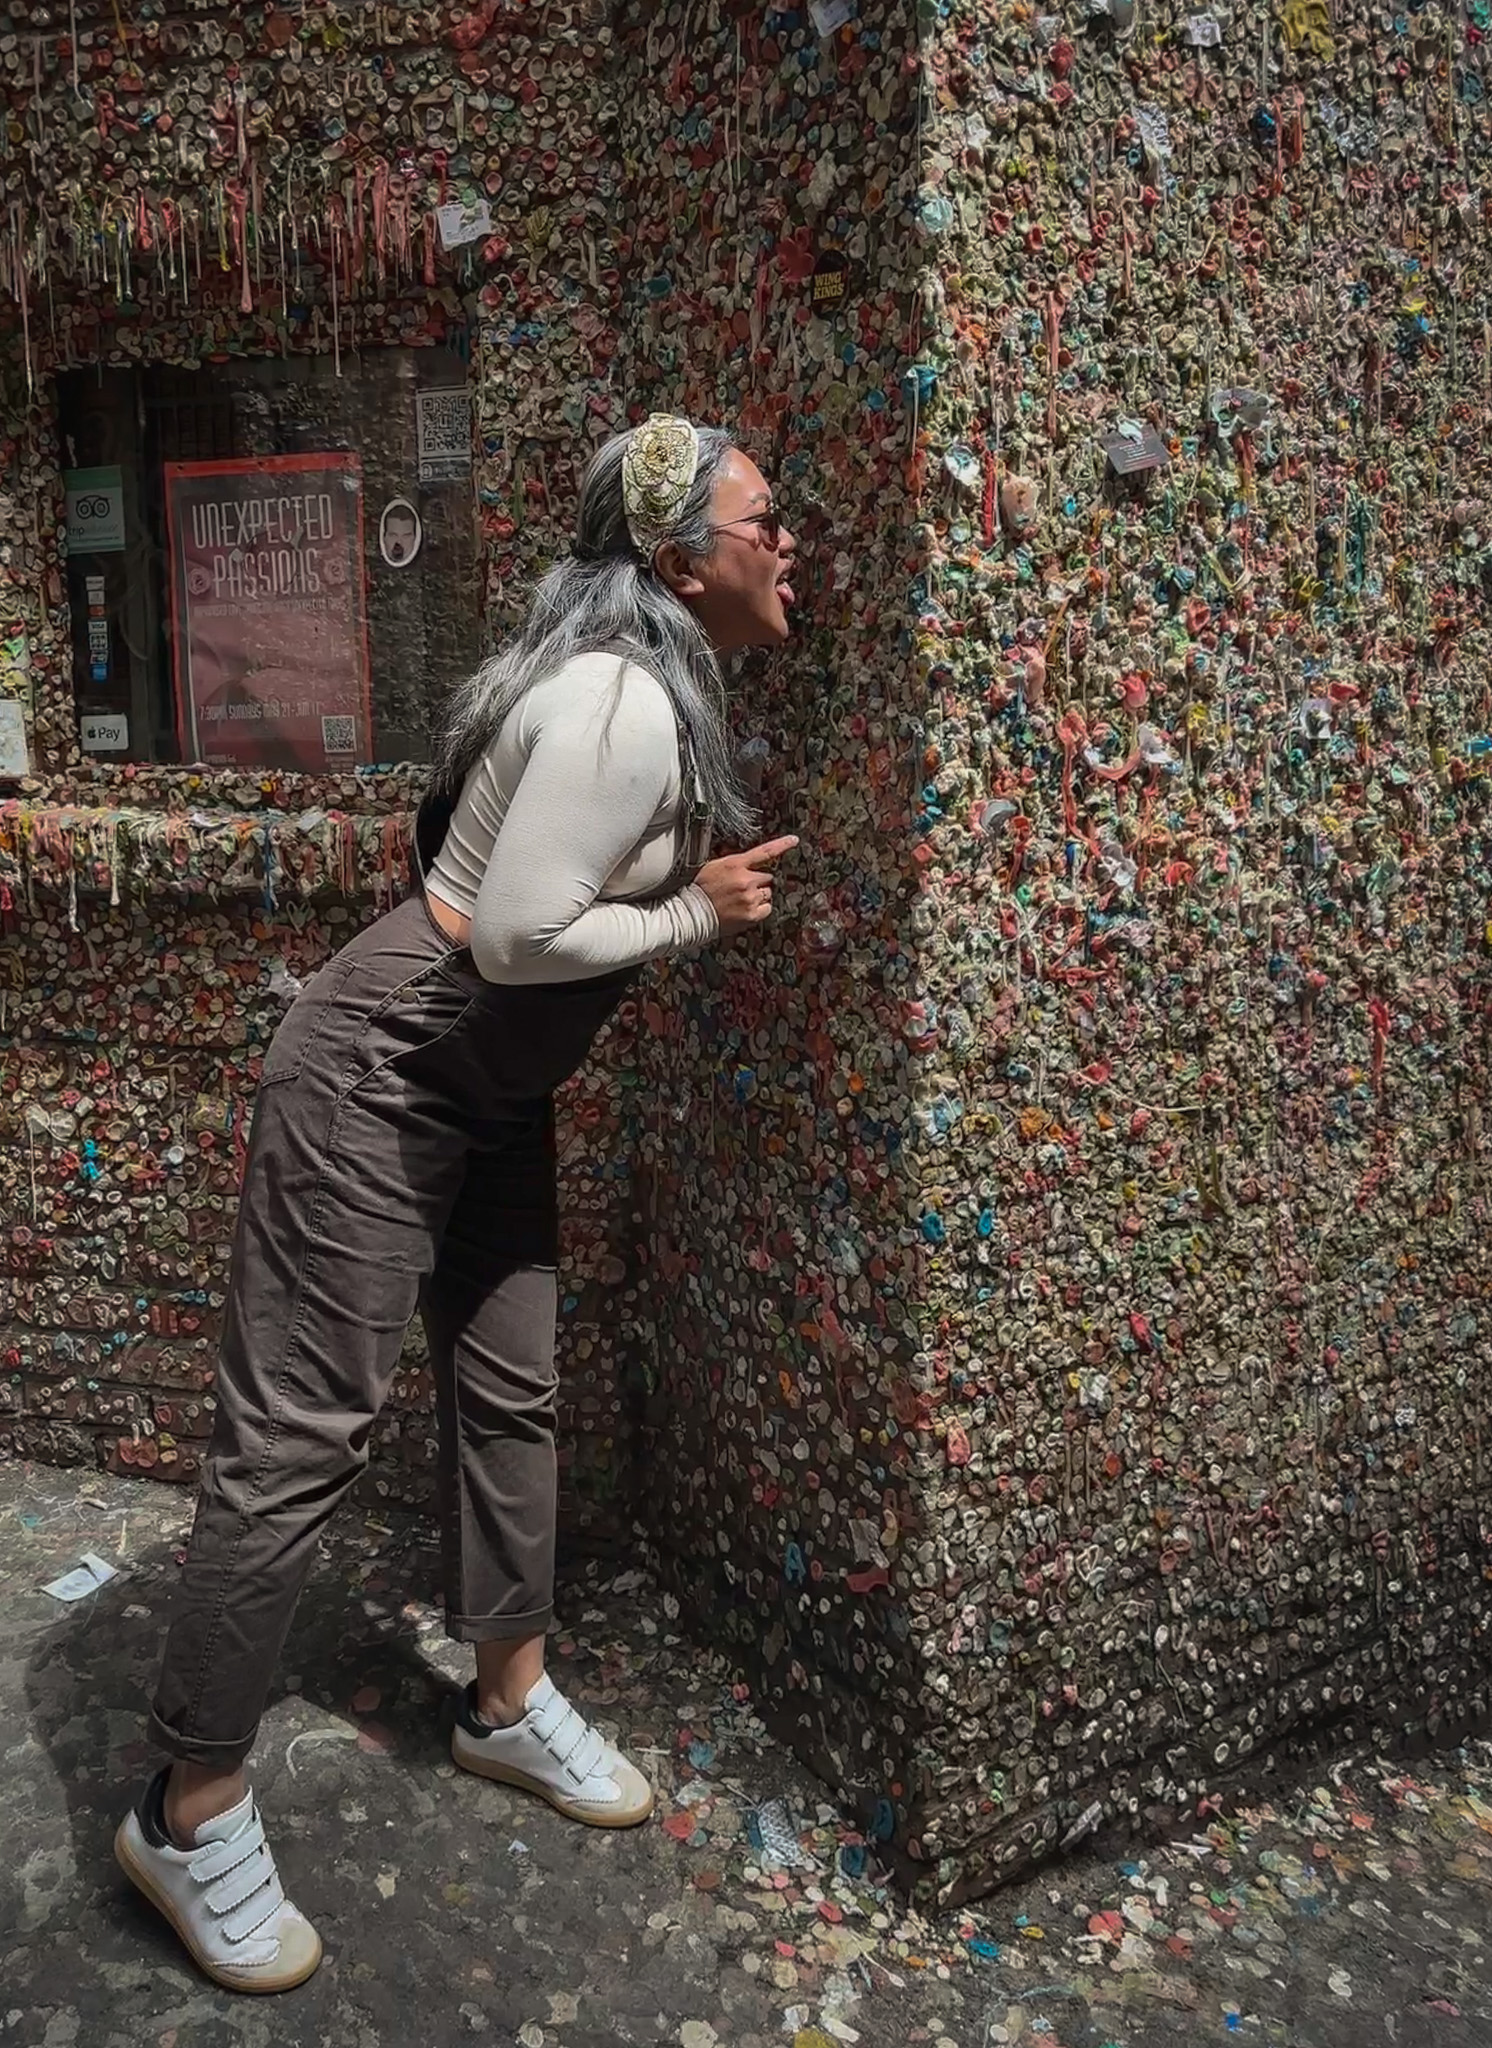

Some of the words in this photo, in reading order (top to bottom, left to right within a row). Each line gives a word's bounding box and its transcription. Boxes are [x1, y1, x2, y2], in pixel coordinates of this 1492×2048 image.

[814, 272, 842, 287] WING
[813, 284, 844, 300] KINGS
[192, 494, 334, 548] UNEXPECTED
[213, 548, 320, 599] PASSIONS
[98, 726, 121, 742] Pay
